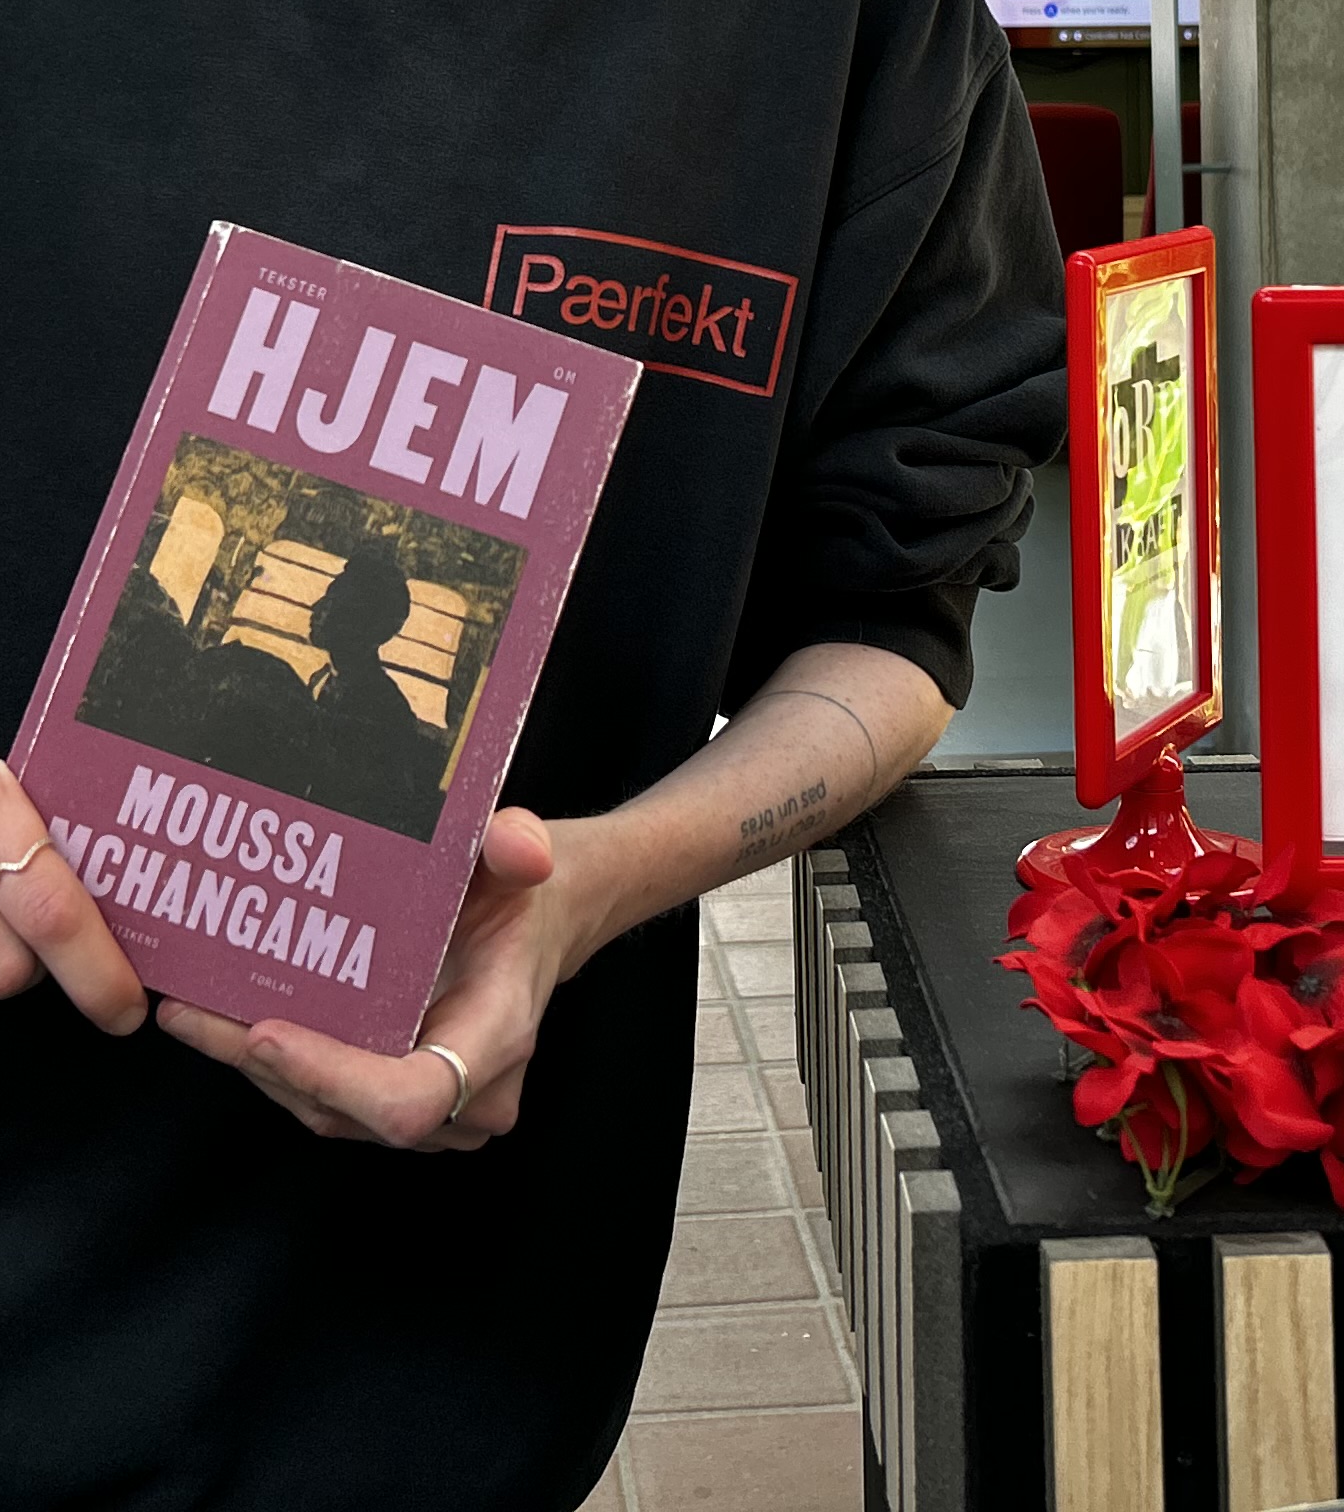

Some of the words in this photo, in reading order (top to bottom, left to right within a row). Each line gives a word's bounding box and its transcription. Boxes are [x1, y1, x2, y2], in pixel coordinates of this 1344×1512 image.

[258, 266, 328, 301] TEKSTER
[553, 365, 577, 385] OM
[513, 253, 755, 359] Pærfekt
[207, 286, 570, 520] HJEM
[116, 764, 344, 898] MOUSSA
[740, 808, 774, 840] bras
[777, 797, 798, 819] un
[800, 776, 827, 809] pas
[48, 816, 376, 990] MCHANGAMA
[250, 972, 295, 997] FORLAG
